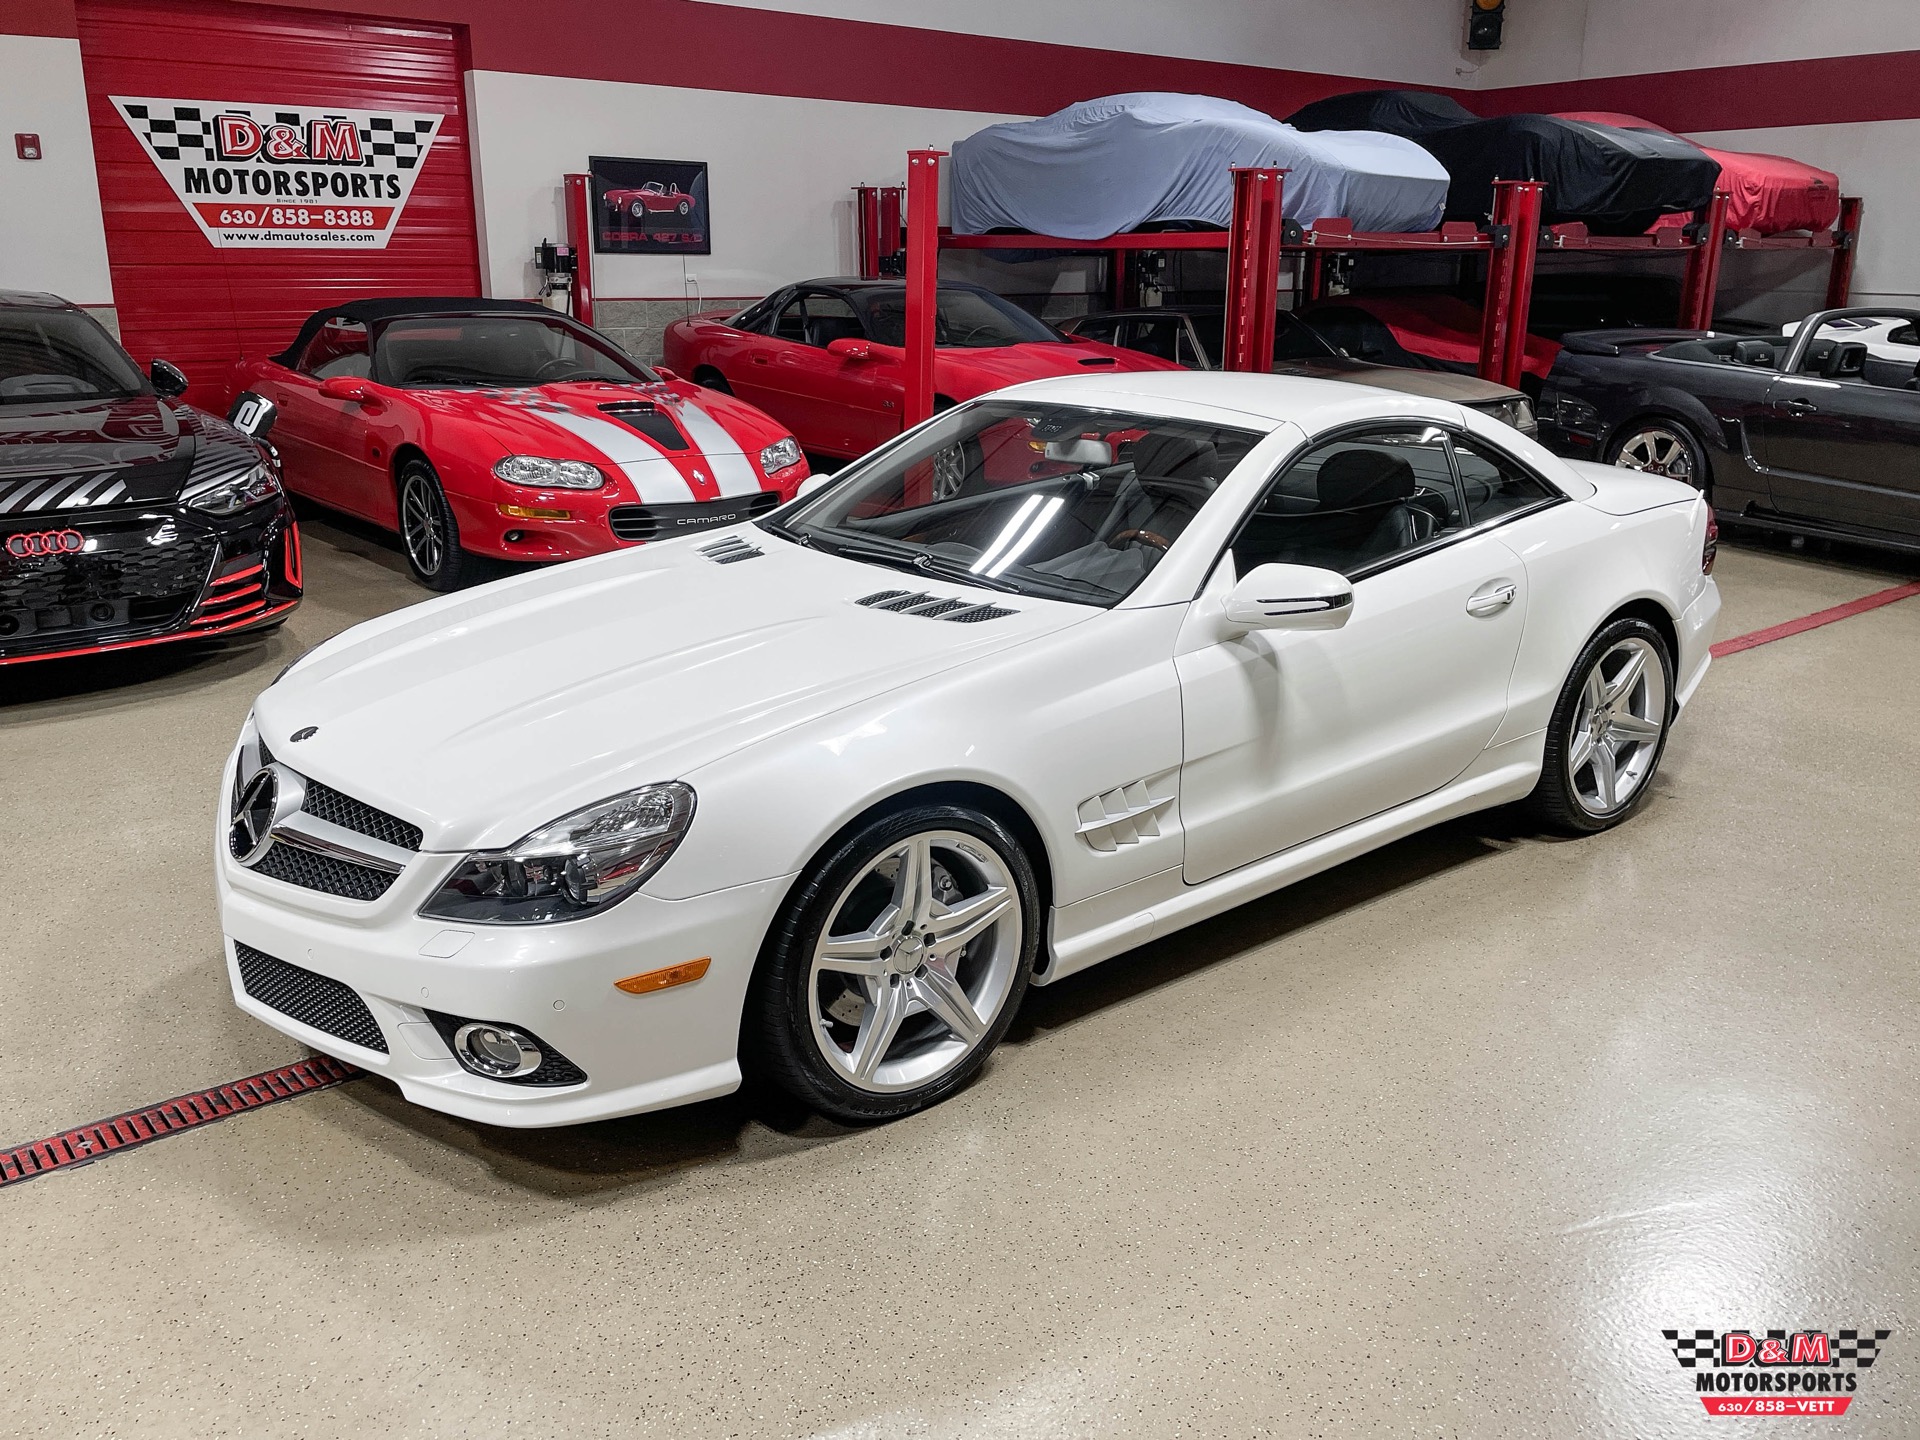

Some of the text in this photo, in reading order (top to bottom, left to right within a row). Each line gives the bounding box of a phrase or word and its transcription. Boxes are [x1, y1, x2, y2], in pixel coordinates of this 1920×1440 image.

[212, 114, 366, 166] D&M
[184, 167, 401, 199] MOTORSPORTS
[219, 206, 375, 227] 630/858-8388
[223, 230, 376, 242] www.dmautosales.com
[602, 232, 648, 242] COBRA
[653, 233, 677, 242] 427
[677, 513, 736, 525] CAMARO
